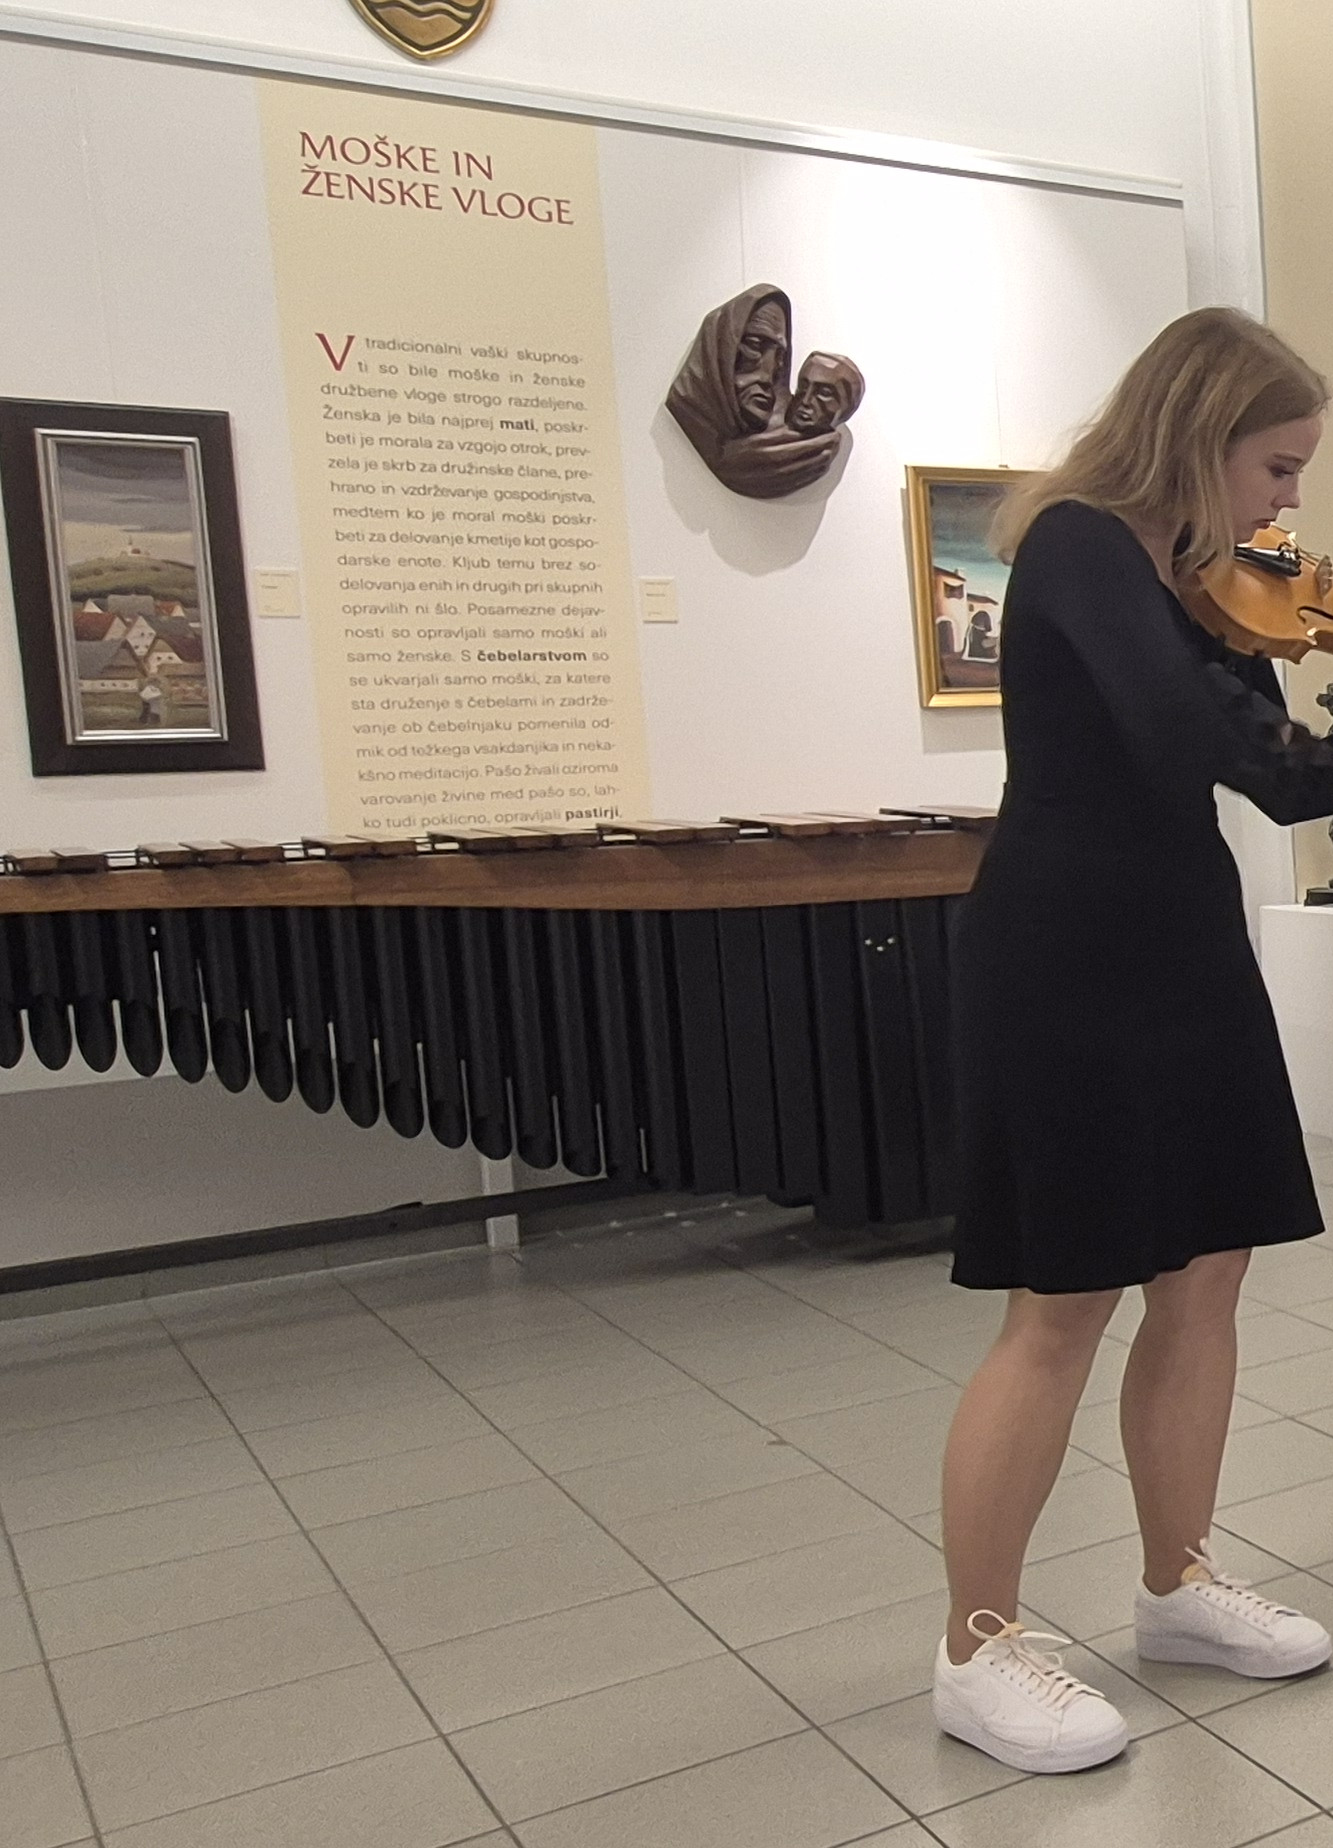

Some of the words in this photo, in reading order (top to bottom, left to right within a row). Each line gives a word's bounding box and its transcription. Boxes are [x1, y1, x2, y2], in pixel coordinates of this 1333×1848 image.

[300, 132, 440, 174] MOŠKE
[453, 151, 494, 181] IN
[301, 164, 442, 211] ŽENSKE
[451, 186, 574, 225] VLOGE
[315, 332, 356, 371] V
[364, 335, 462, 355] tradicionalni
[469, 344, 509, 358] vaški
[357, 359, 369, 372] ti
[407, 362, 438, 376] bile
[447, 367, 500, 381] moške
[532, 371, 586, 387] ženske
[319, 381, 398, 398] družbene
[403, 387, 447, 404] vloge
[452, 390, 502, 407] strogo
[322, 404, 381, 421] Ženska
[386, 409, 401, 425] je
[406, 410, 435, 424] bila
[440, 413, 494, 431] najprej
[498, 417, 540, 432] mati,
[324, 430, 356, 444] beti
[359, 432, 375, 448] je
[377, 435, 433, 448] morala
[436, 440, 454, 449] za
[457, 439, 507, 455] vzgojo
[327, 455, 360, 468] zela
[363, 456, 379, 472] je
[381, 458, 416, 471] skrb
[419, 462, 437, 472] za
[439, 460, 514, 476] družinske
[329, 479, 376, 493] hrano
[400, 483, 488, 501] vzdrževanje
[331, 504, 400, 518] medtem
[405, 506, 425, 519] ko
[430, 506, 445, 522] je
[451, 509, 495, 521] moral
[501, 510, 546, 523] moški
[334, 528, 365, 541] beti
[367, 532, 387, 542] za
[388, 529, 464, 547] delovanje
[465, 531, 521, 549] kmetije
[523, 533, 546, 546] kot
[336, 552, 391, 566] darske
[451, 554, 491, 571] Kljub
[496, 555, 535, 569] temu
[540, 556, 573, 570] brez
[338, 576, 416, 593] delovanja
[417, 578, 453, 591] enih
[471, 578, 521, 595] drugih
[523, 579, 544, 595] pri
[545, 580, 603, 596] skupnih
[341, 601, 409, 616] opravilih
[414, 601, 429, 614] ni
[466, 601, 556, 615] Posamezne
[343, 625, 385, 638] nosti
[491, 629, 535, 638] samo
[540, 625, 585, 638] moški
[346, 652, 391, 662] samo
[460, 648, 471, 661] S
[476, 648, 587, 661] čebelarstvom
[348, 676, 368, 686] se
[372, 672, 439, 688] ukvarjali
[443, 675, 487, 685] samo
[544, 674, 562, 684] za
[565, 670, 612, 683] katere
[350, 697, 375, 709] sta
[379, 695, 450, 711] druženje
[466, 694, 537, 708] čebelami
[352, 720, 397, 736] vanje
[401, 719, 423, 732] ob
[426, 717, 513, 734] čebelnjaku
[516, 716, 586, 733] pomenila
